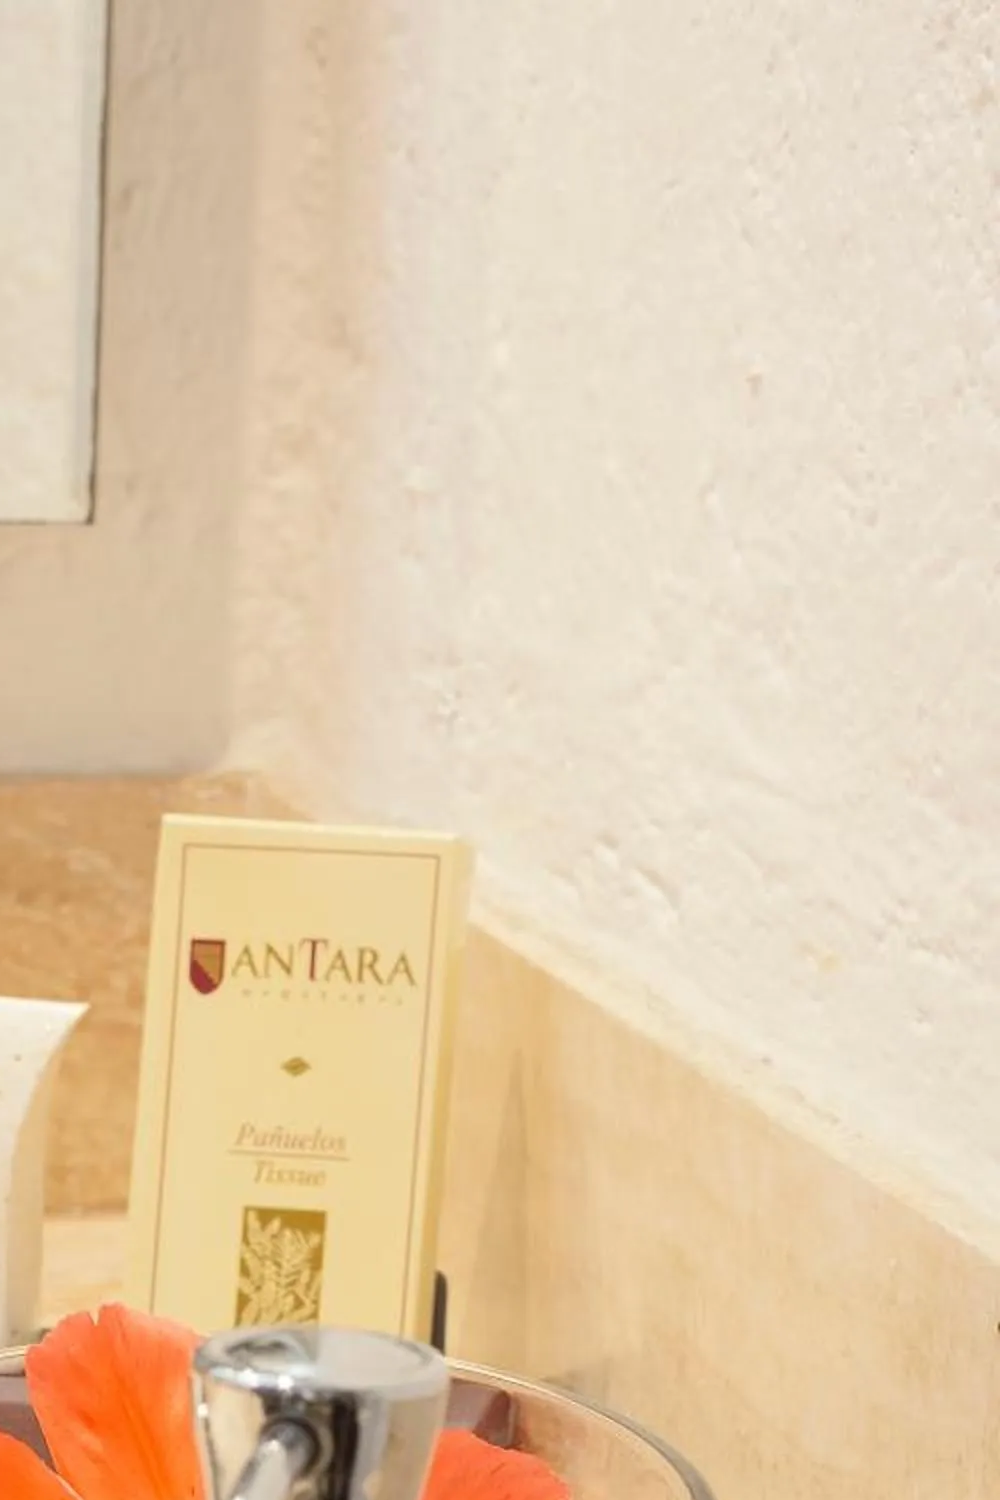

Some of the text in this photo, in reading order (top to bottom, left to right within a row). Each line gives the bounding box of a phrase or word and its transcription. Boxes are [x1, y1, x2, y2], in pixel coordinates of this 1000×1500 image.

[231, 937, 418, 988] ANTARA
[234, 1120, 348, 1151] Pañuelos
[252, 1159, 327, 1188] Tissue
